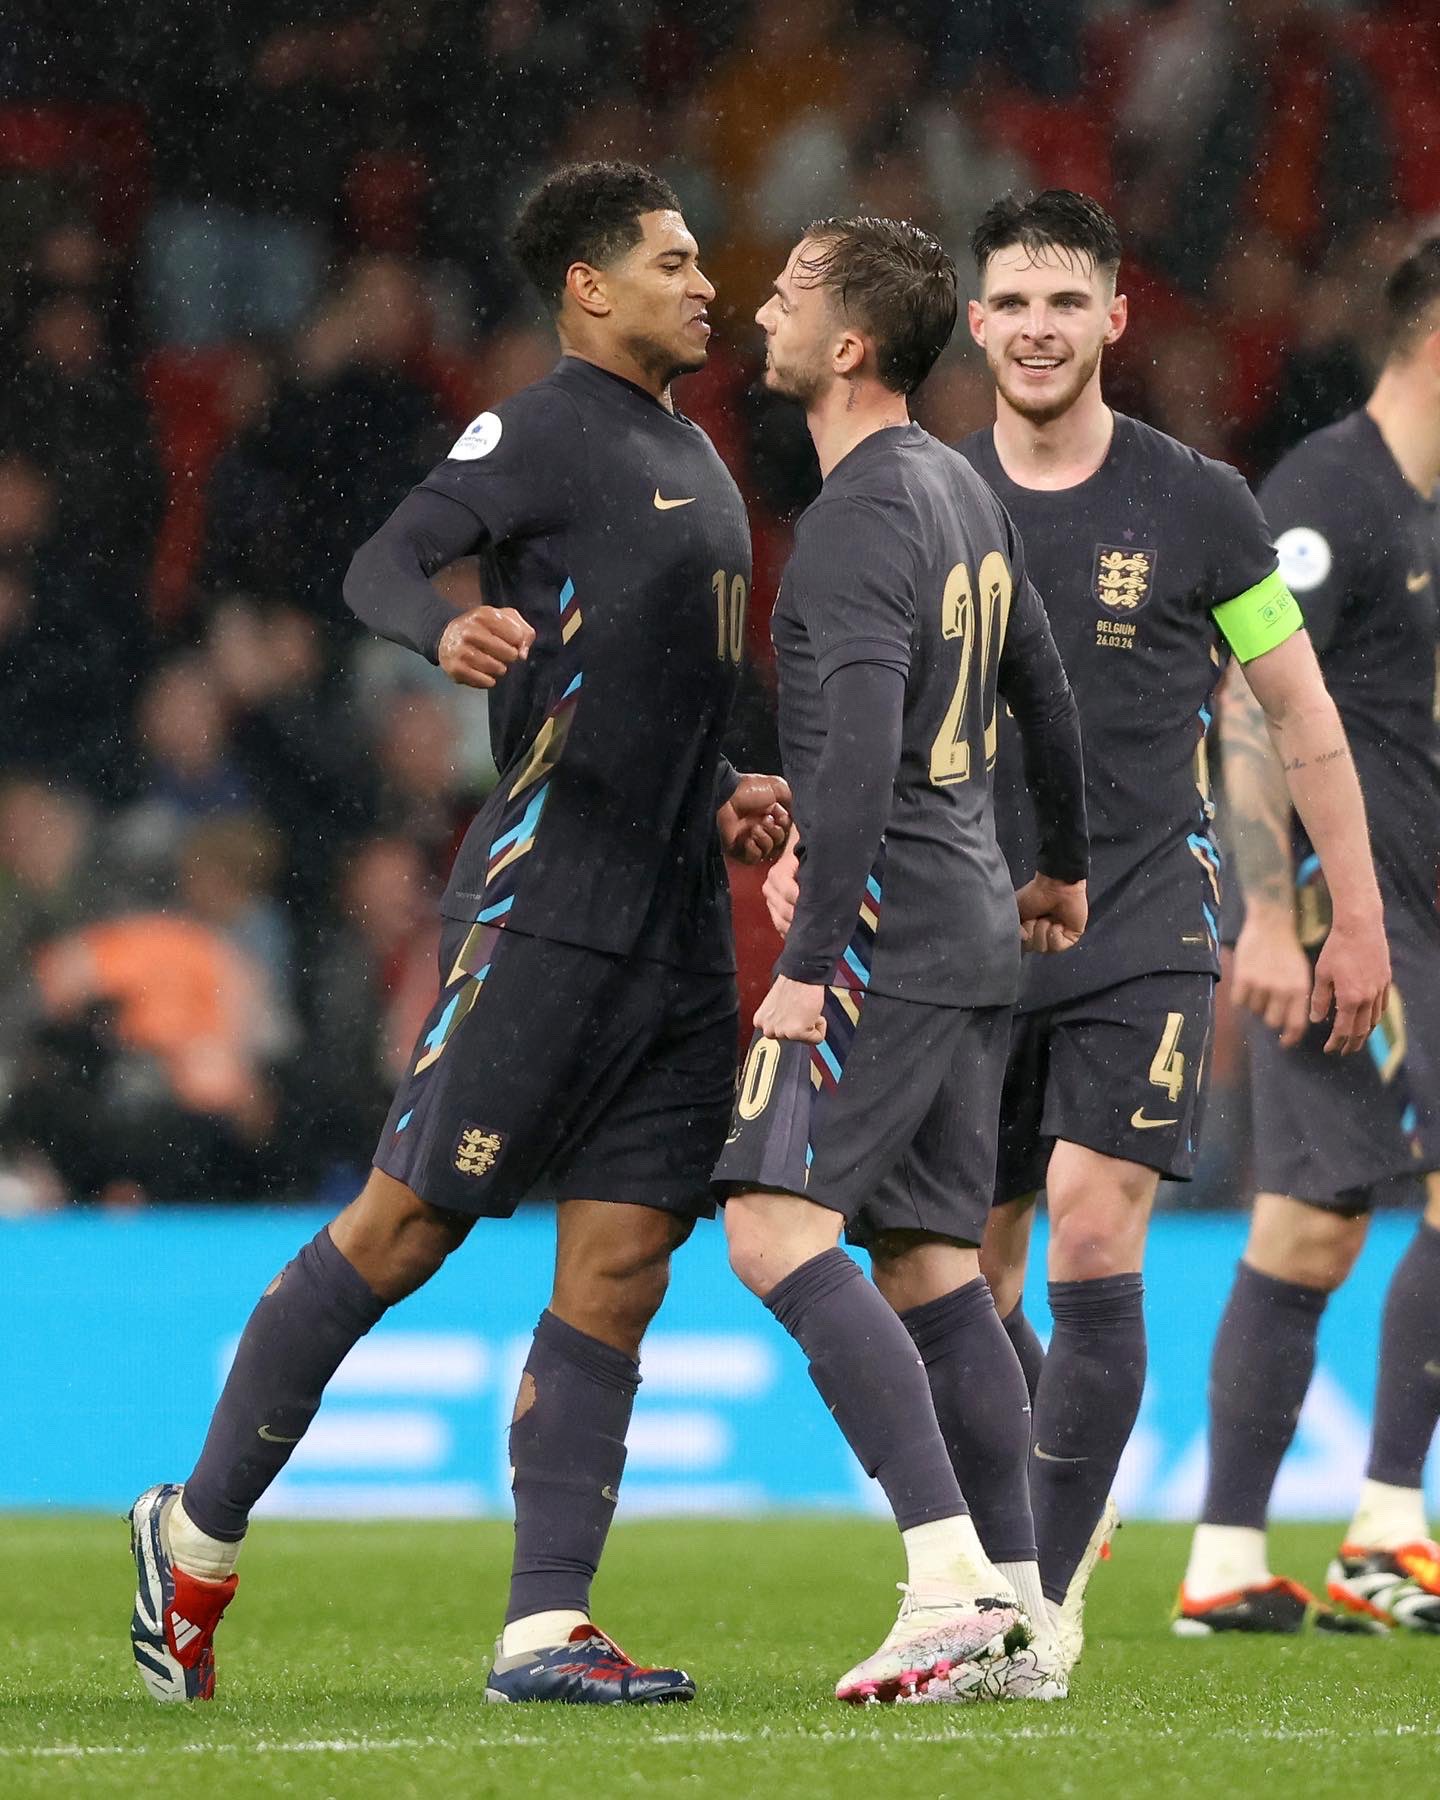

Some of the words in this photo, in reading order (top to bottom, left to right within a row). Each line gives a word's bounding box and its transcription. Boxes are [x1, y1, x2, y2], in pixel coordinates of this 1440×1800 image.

[711, 568, 747, 667] 10
[1096, 620, 1136, 636] BELGIUM
[1096, 634, 1133, 649] 26.03.24
[929, 550, 1013, 787] 20
[736, 1036, 781, 1120] 0
[1149, 1012, 1184, 1102] 4
